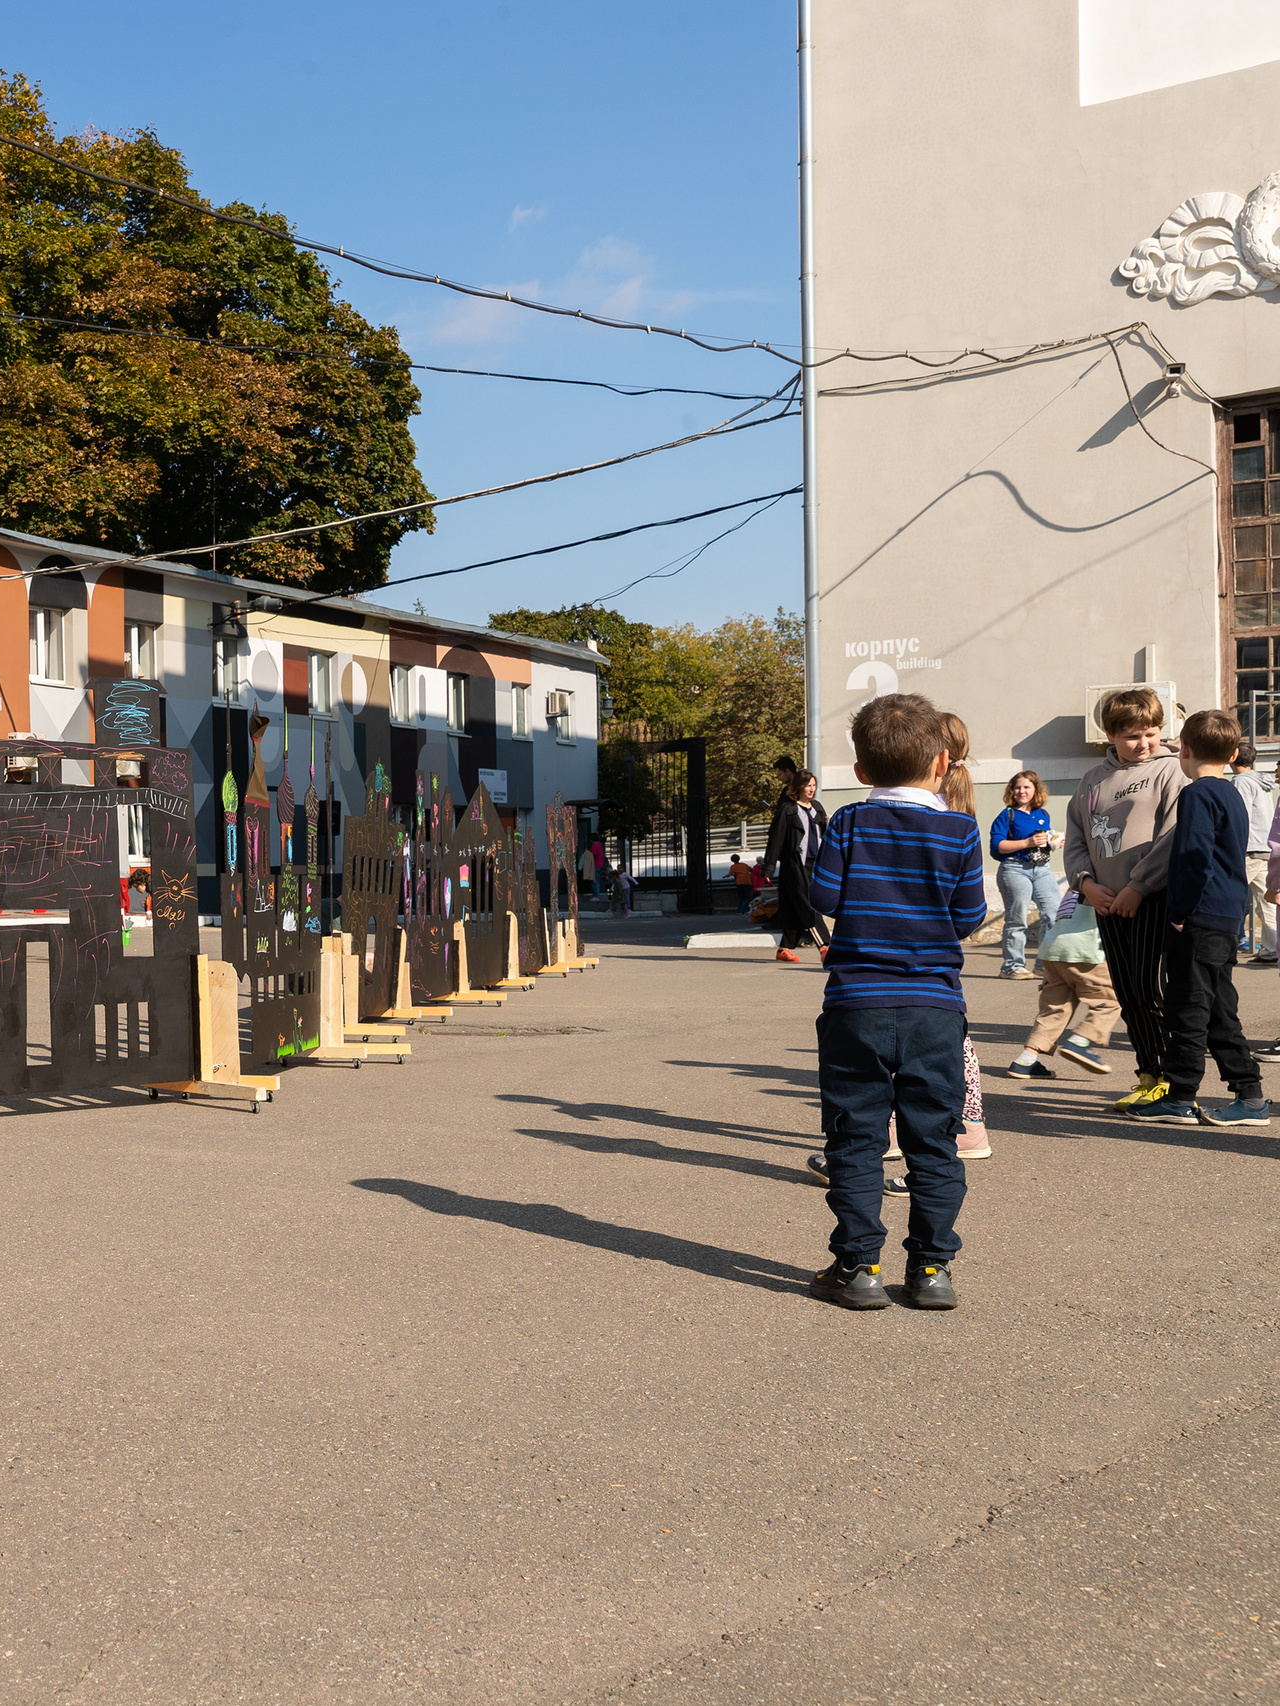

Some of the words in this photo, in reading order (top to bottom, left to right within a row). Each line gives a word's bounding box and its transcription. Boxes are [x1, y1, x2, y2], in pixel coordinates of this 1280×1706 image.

[845, 637, 921, 661] корпус
[896, 656, 942, 670] building
[1113, 777, 1150, 802] SWEET!
